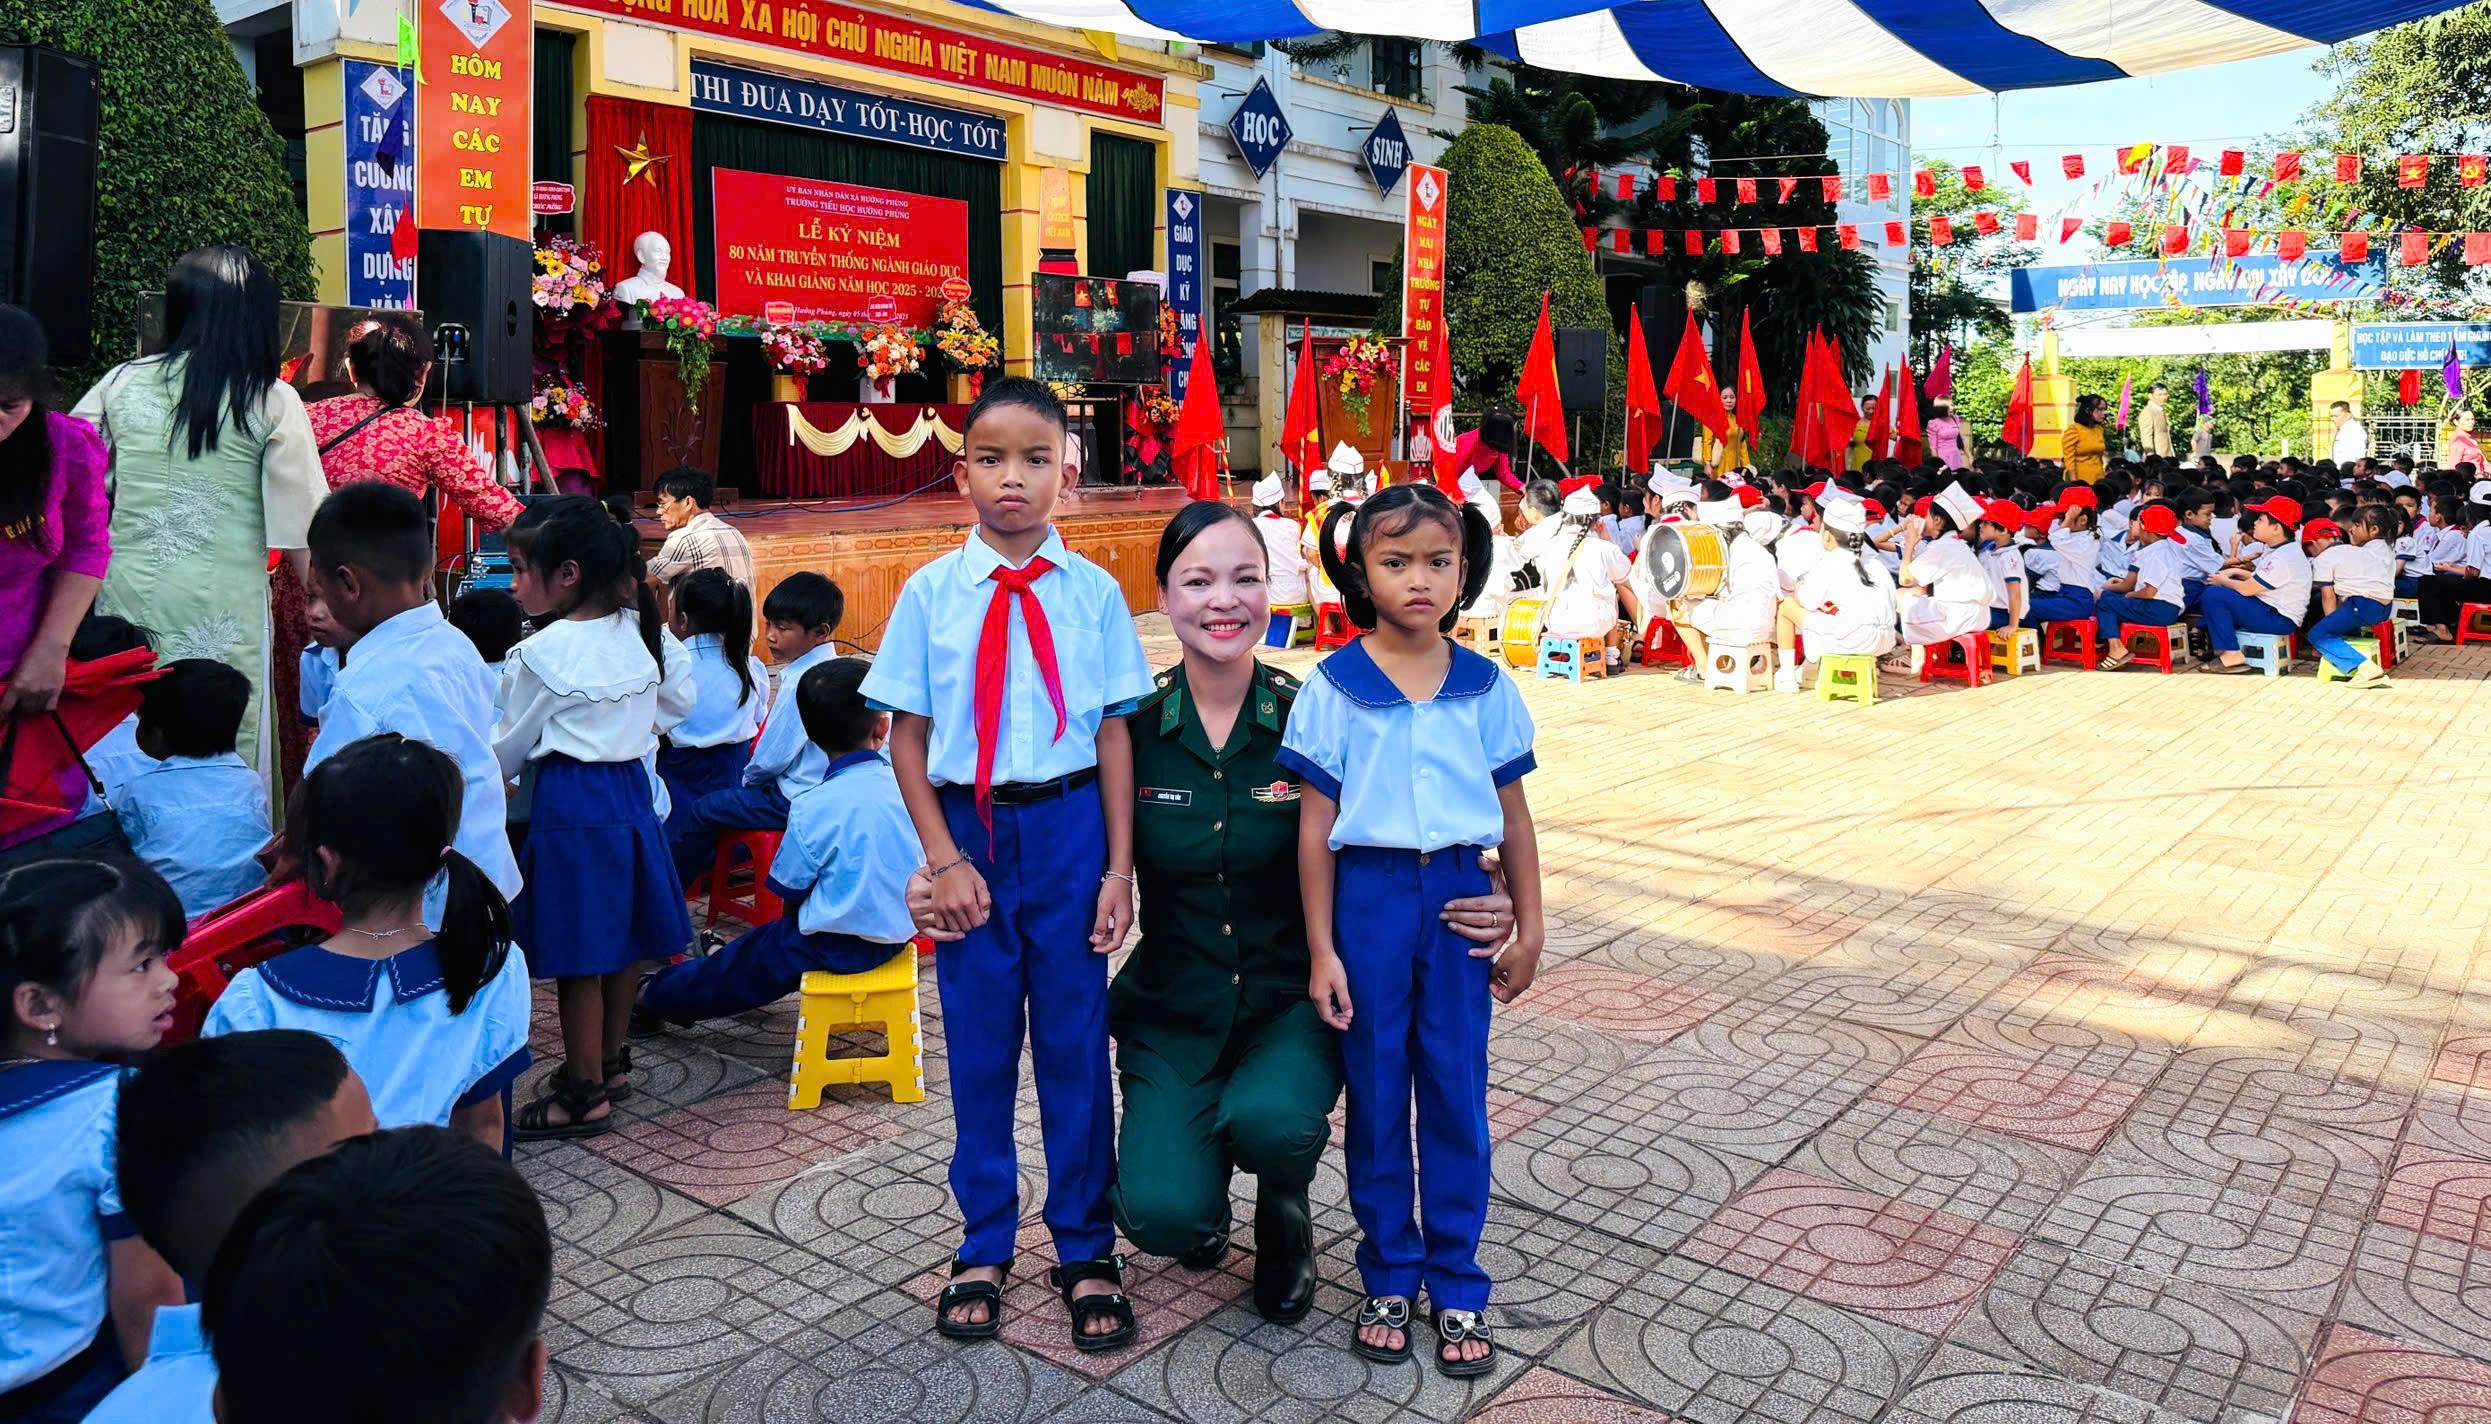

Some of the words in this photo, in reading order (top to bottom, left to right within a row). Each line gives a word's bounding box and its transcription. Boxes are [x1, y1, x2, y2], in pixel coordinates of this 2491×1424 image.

[450, 52, 502, 80] HÔM
[781, 3, 818, 48] HỘI
[826, 14, 867, 53] CHỦ
[874, 30, 934, 68] NGHĨA
[939, 41, 978, 80] VIỆT
[985, 52, 1026, 88] NAM
[1030, 63, 1079, 99] MUÔN
[1082, 73, 1119, 106] NĂM
[450, 92, 502, 117] NAY
[691, 72, 731, 104] THI
[798, 92, 847, 127] DẠY
[960, 122, 999, 150] TỐT
[452, 127, 501, 153] CÁC
[1242, 111, 1279, 152] HỌC
[1372, 136, 1403, 169] SINH
[459, 167, 493, 190] EM
[459, 204, 493, 231] TỰ
[799, 218, 822, 240] LỄ
[828, 223, 851, 243] KỶ
[857, 227, 900, 249] NIỆM
[1174, 222, 1193, 243] GIÁO
[729, 246, 744, 260] 80
[747, 245, 775, 262] NĂM
[778, 246, 826, 266] TRUYỀN
[830, 249, 869, 271] THỐNG
[872, 256, 910, 274] NGÀNH
[912, 260, 937, 277] GIÁO
[1176, 254, 1192, 276] DỤC
[745, 267, 763, 285] VÀ
[767, 272, 796, 287] KHAI
[799, 271, 836, 291] GIẢNG
[839, 274, 864, 293] NĂM
[892, 283, 917, 296] 2025
[925, 286, 943, 298] 202
[2098, 275, 2128, 296] NAY
[2129, 274, 2161, 300] HỌC
[1415, 381, 1427, 393] EM
